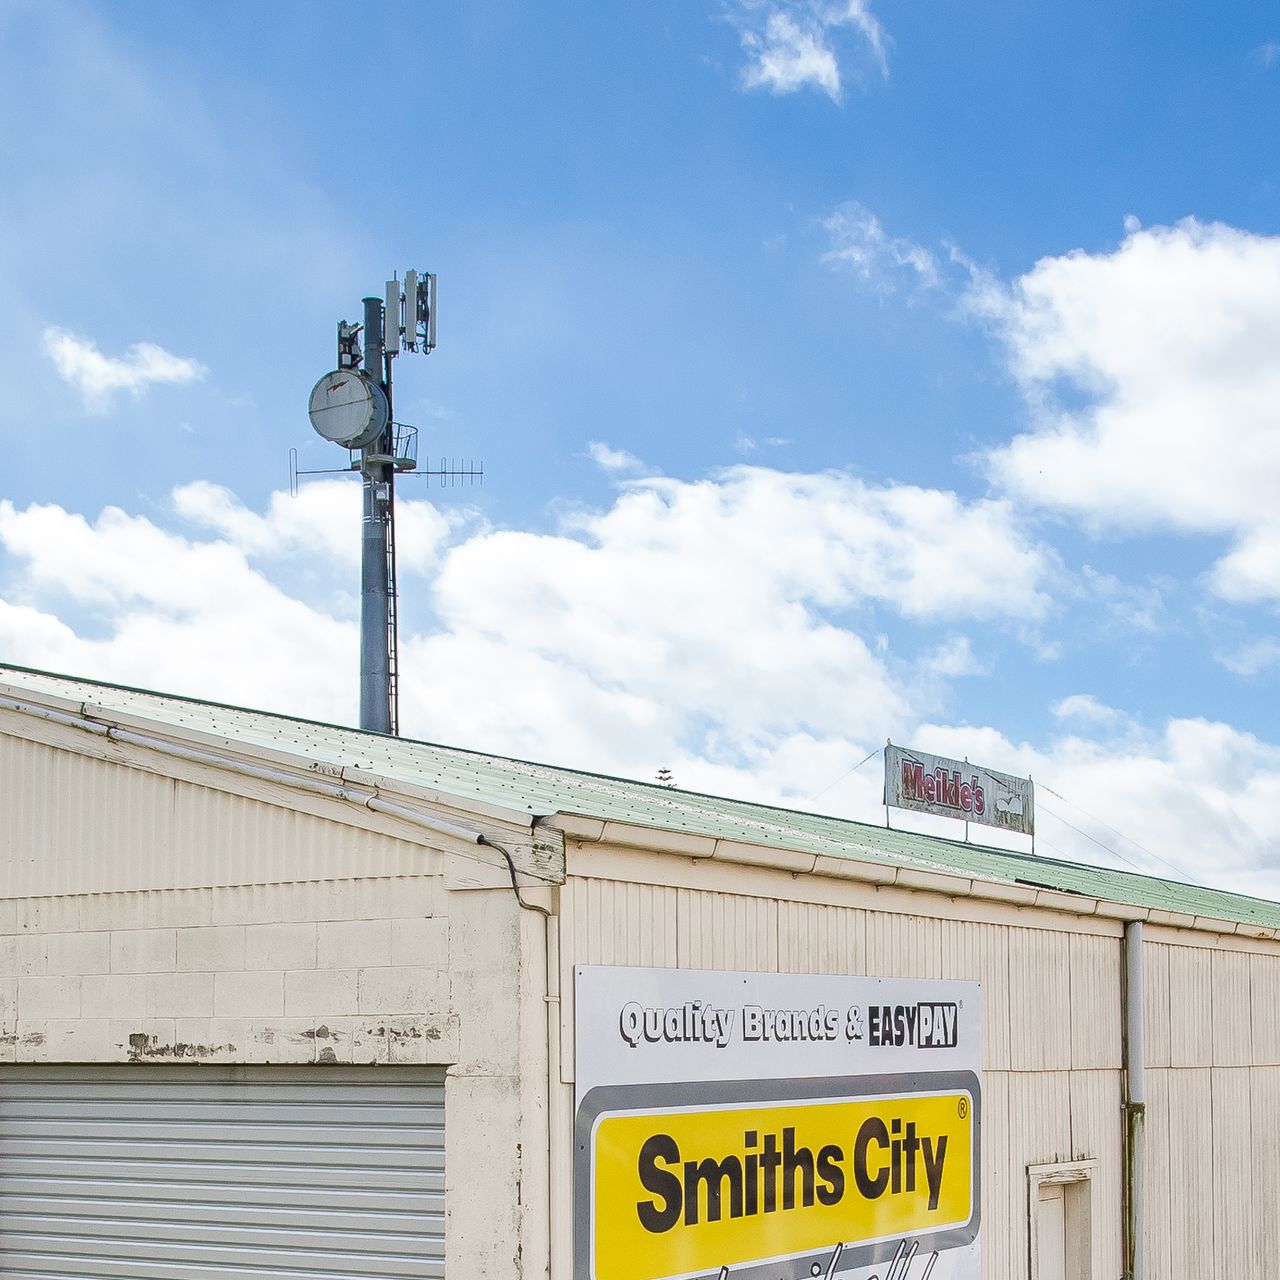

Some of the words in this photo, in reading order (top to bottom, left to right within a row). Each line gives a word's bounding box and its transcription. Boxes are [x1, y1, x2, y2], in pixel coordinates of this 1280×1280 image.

[902, 759, 985, 815] Meikle's
[620, 1001, 735, 1047] Quality
[742, 1005, 838, 1042] Brands
[845, 1004, 864, 1039] &
[636, 1127, 845, 1233] Smiths
[853, 1116, 948, 1211] City
